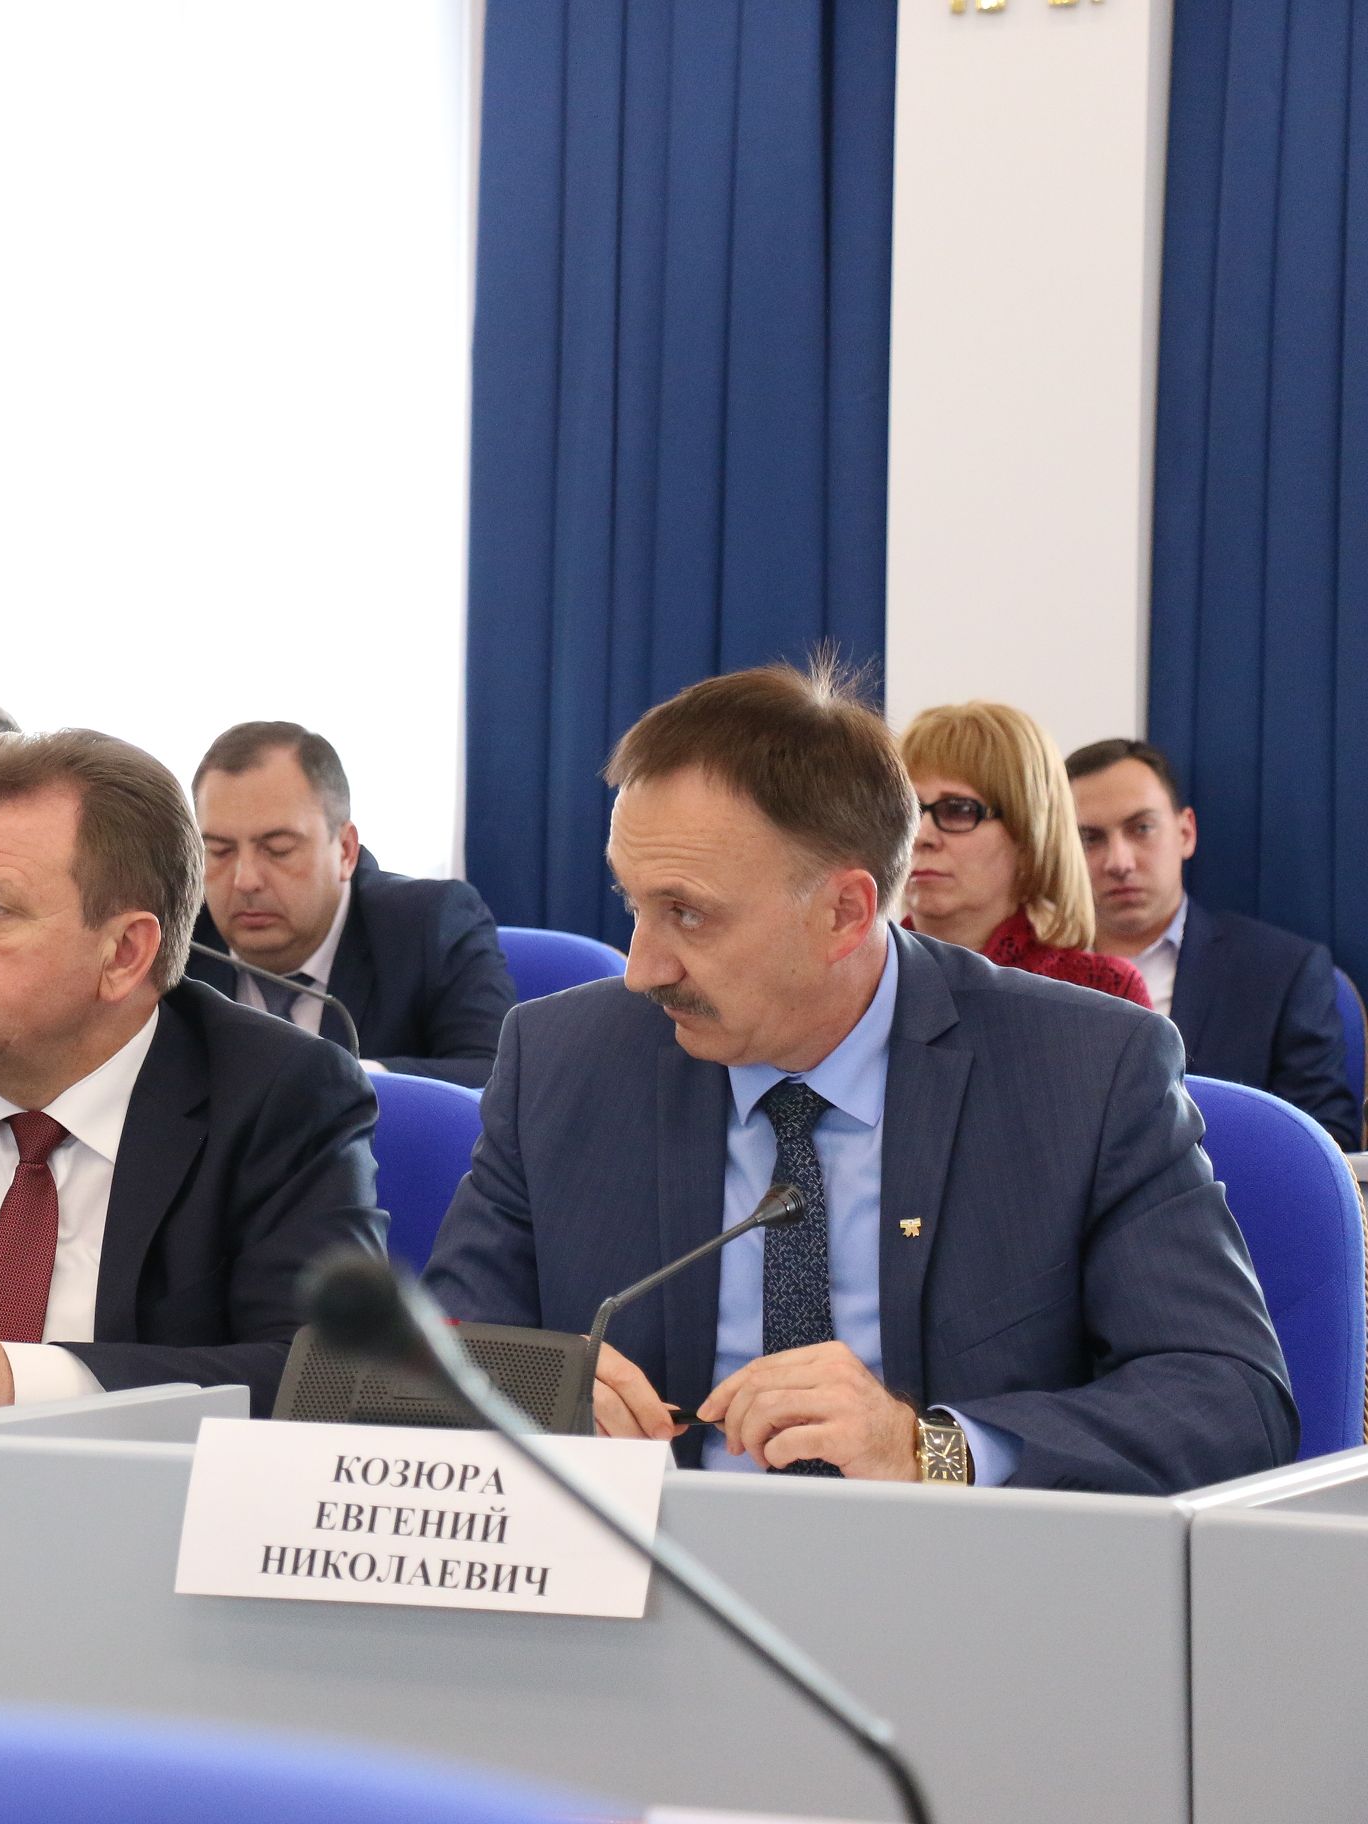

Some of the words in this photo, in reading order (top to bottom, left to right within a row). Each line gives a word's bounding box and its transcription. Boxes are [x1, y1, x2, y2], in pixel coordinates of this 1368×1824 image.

[331, 1454, 506, 1496] КОЗЮРА
[313, 1501, 511, 1544] ЕВГЕНИЙ
[257, 1545, 552, 1597] НИКОЛАЕВИЧ
